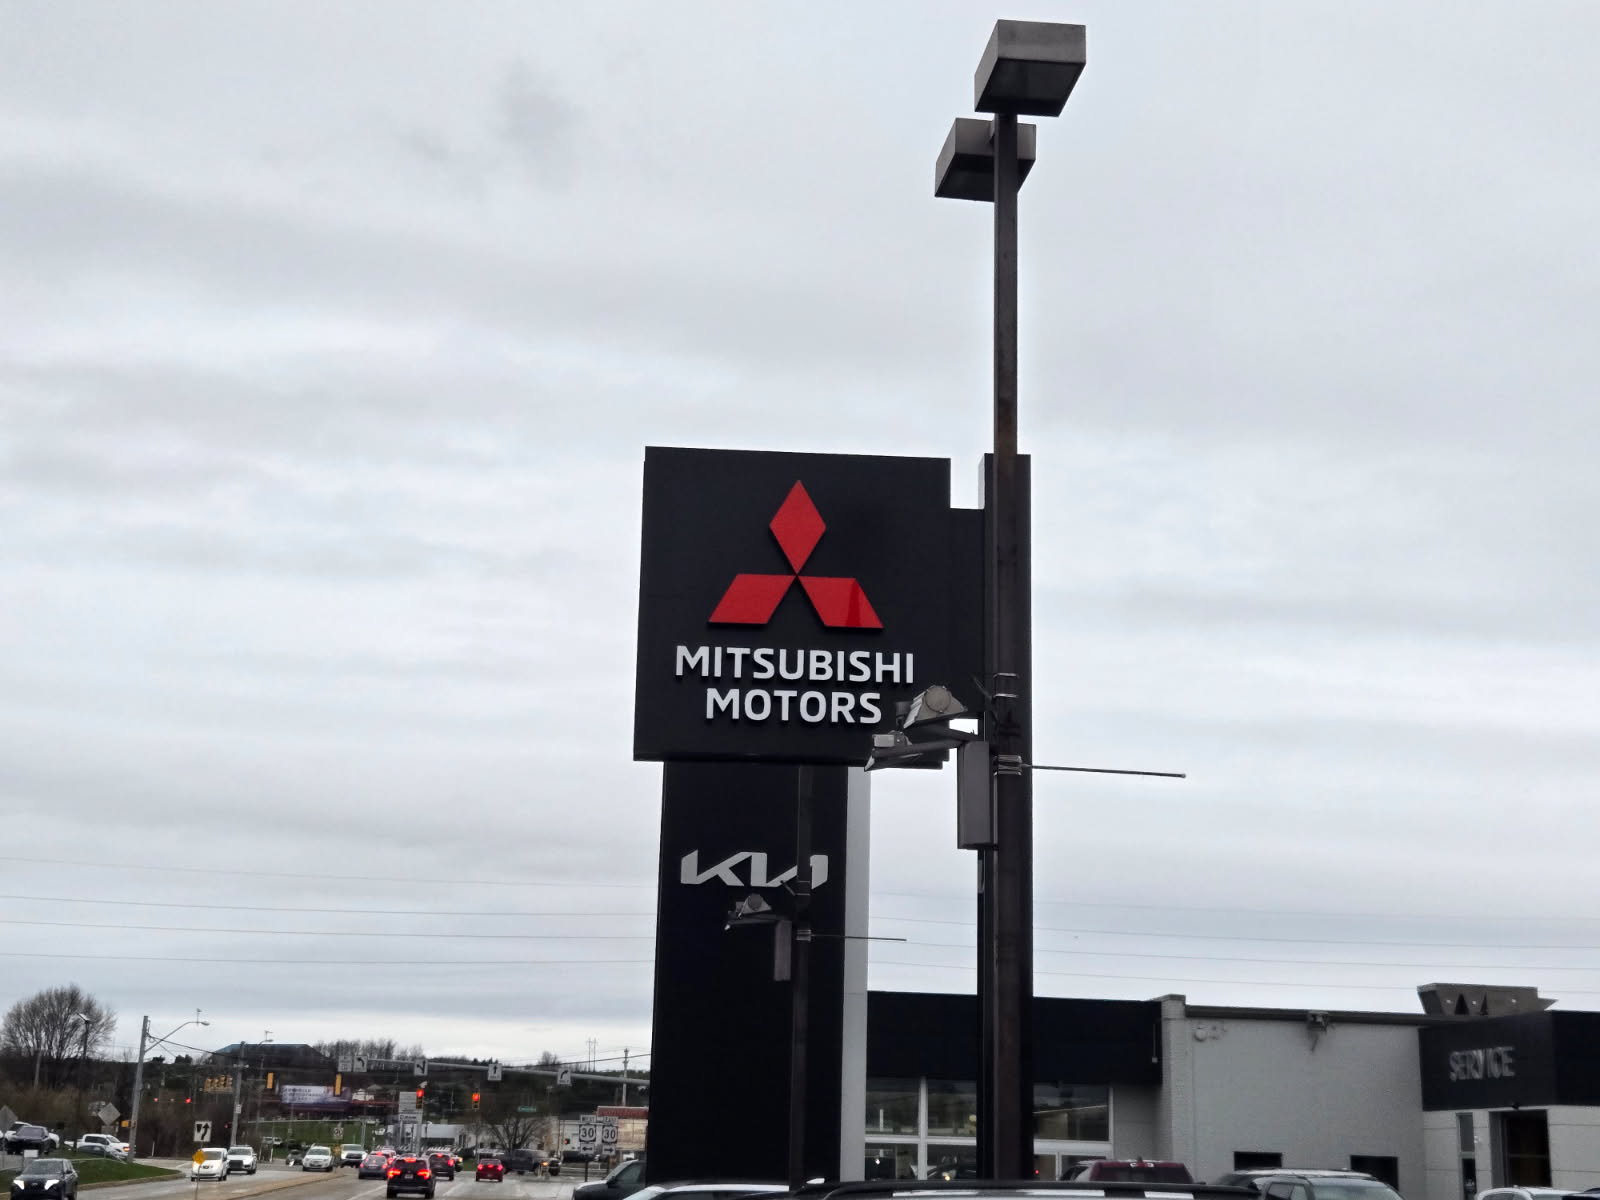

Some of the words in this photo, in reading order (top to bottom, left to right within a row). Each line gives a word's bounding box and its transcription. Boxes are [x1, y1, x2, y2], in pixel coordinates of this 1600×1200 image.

[675, 645, 914, 684] MITSUBISHI
[706, 687, 882, 724] MOTORS
[1450, 1046, 1515, 1082] SERVICE
[581, 1127, 594, 1138] 30
[604, 1129, 616, 1139] 30
